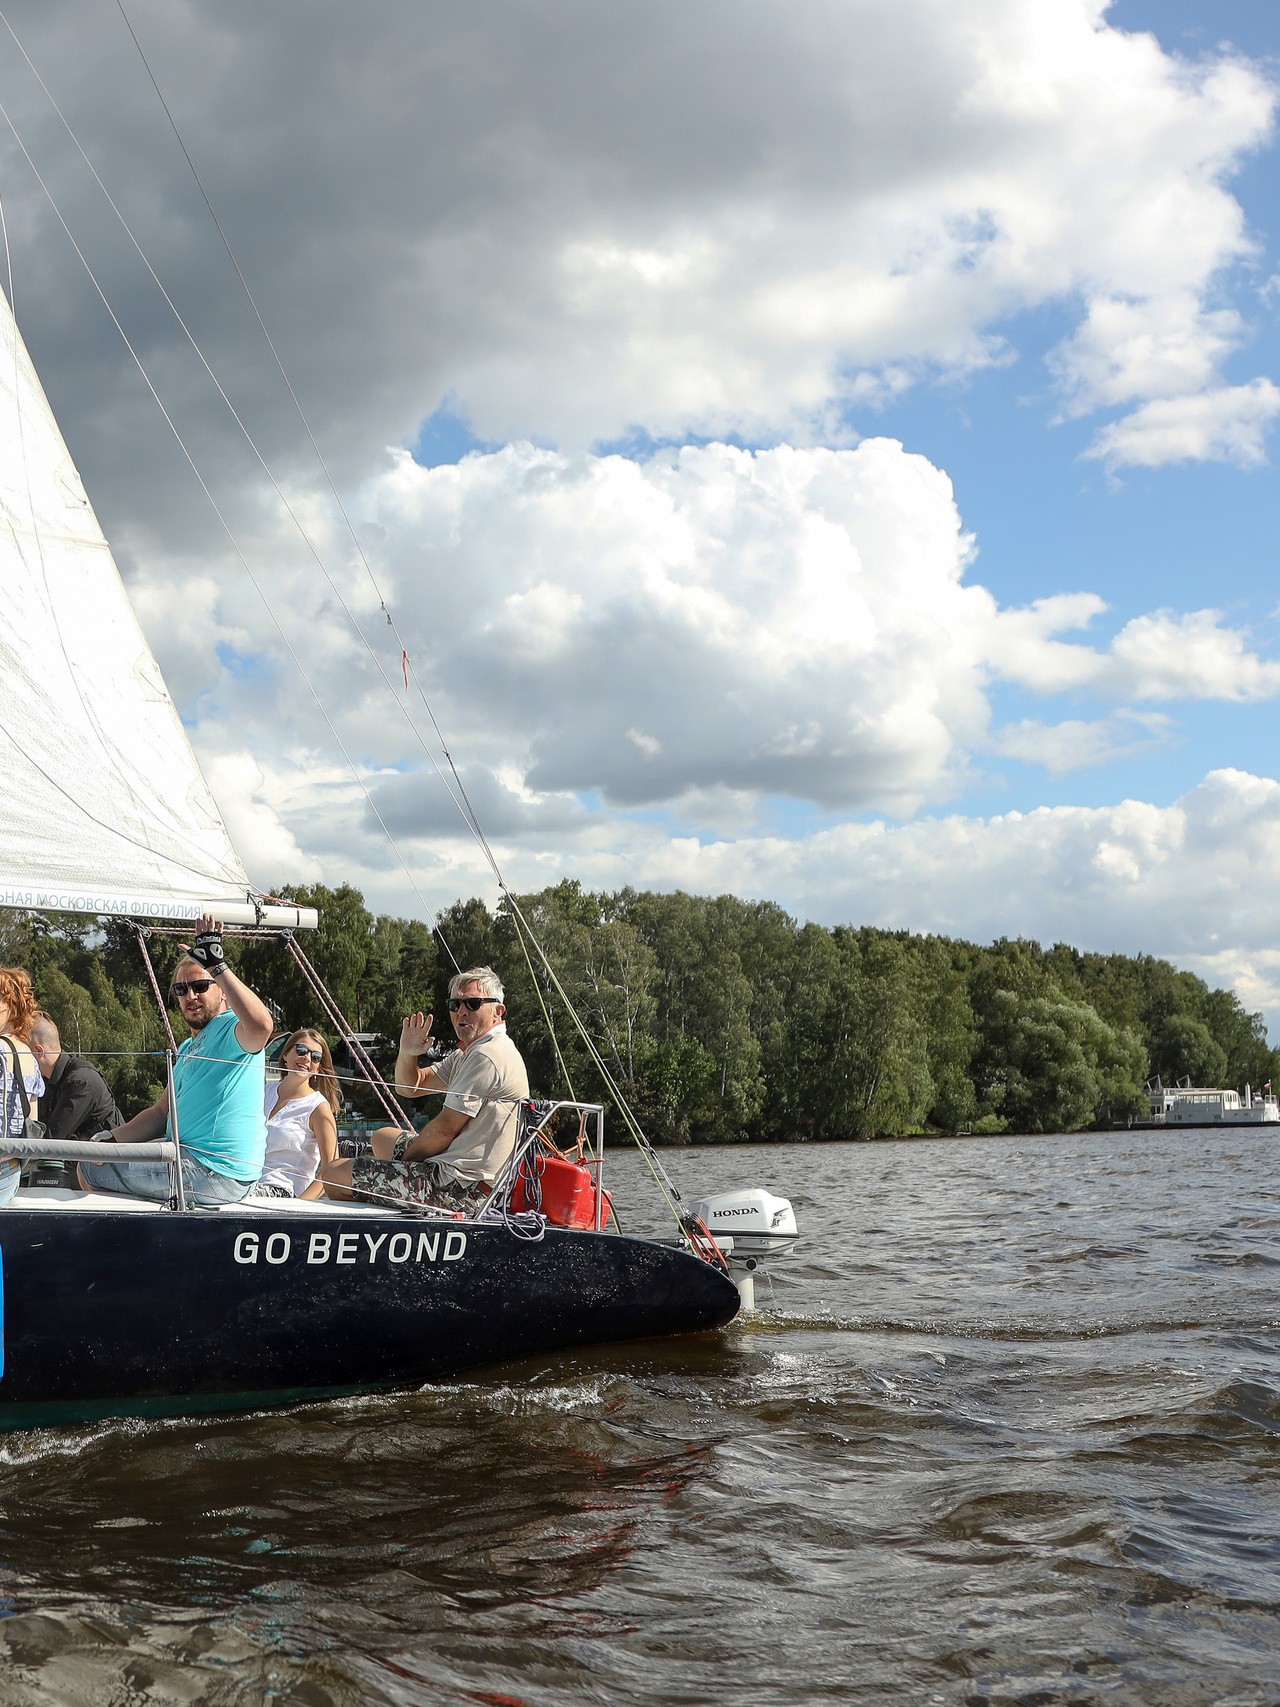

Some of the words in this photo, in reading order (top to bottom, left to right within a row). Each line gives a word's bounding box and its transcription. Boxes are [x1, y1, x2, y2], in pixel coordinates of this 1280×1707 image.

[36, 893, 127, 913] МОСКОВСКАЯ
[130, 901, 201, 918] ФЛОТИЛИЯ
[712, 1207, 760, 1218] HONDA
[233, 1232, 291, 1265] GO
[306, 1231, 468, 1264] BEYOND
